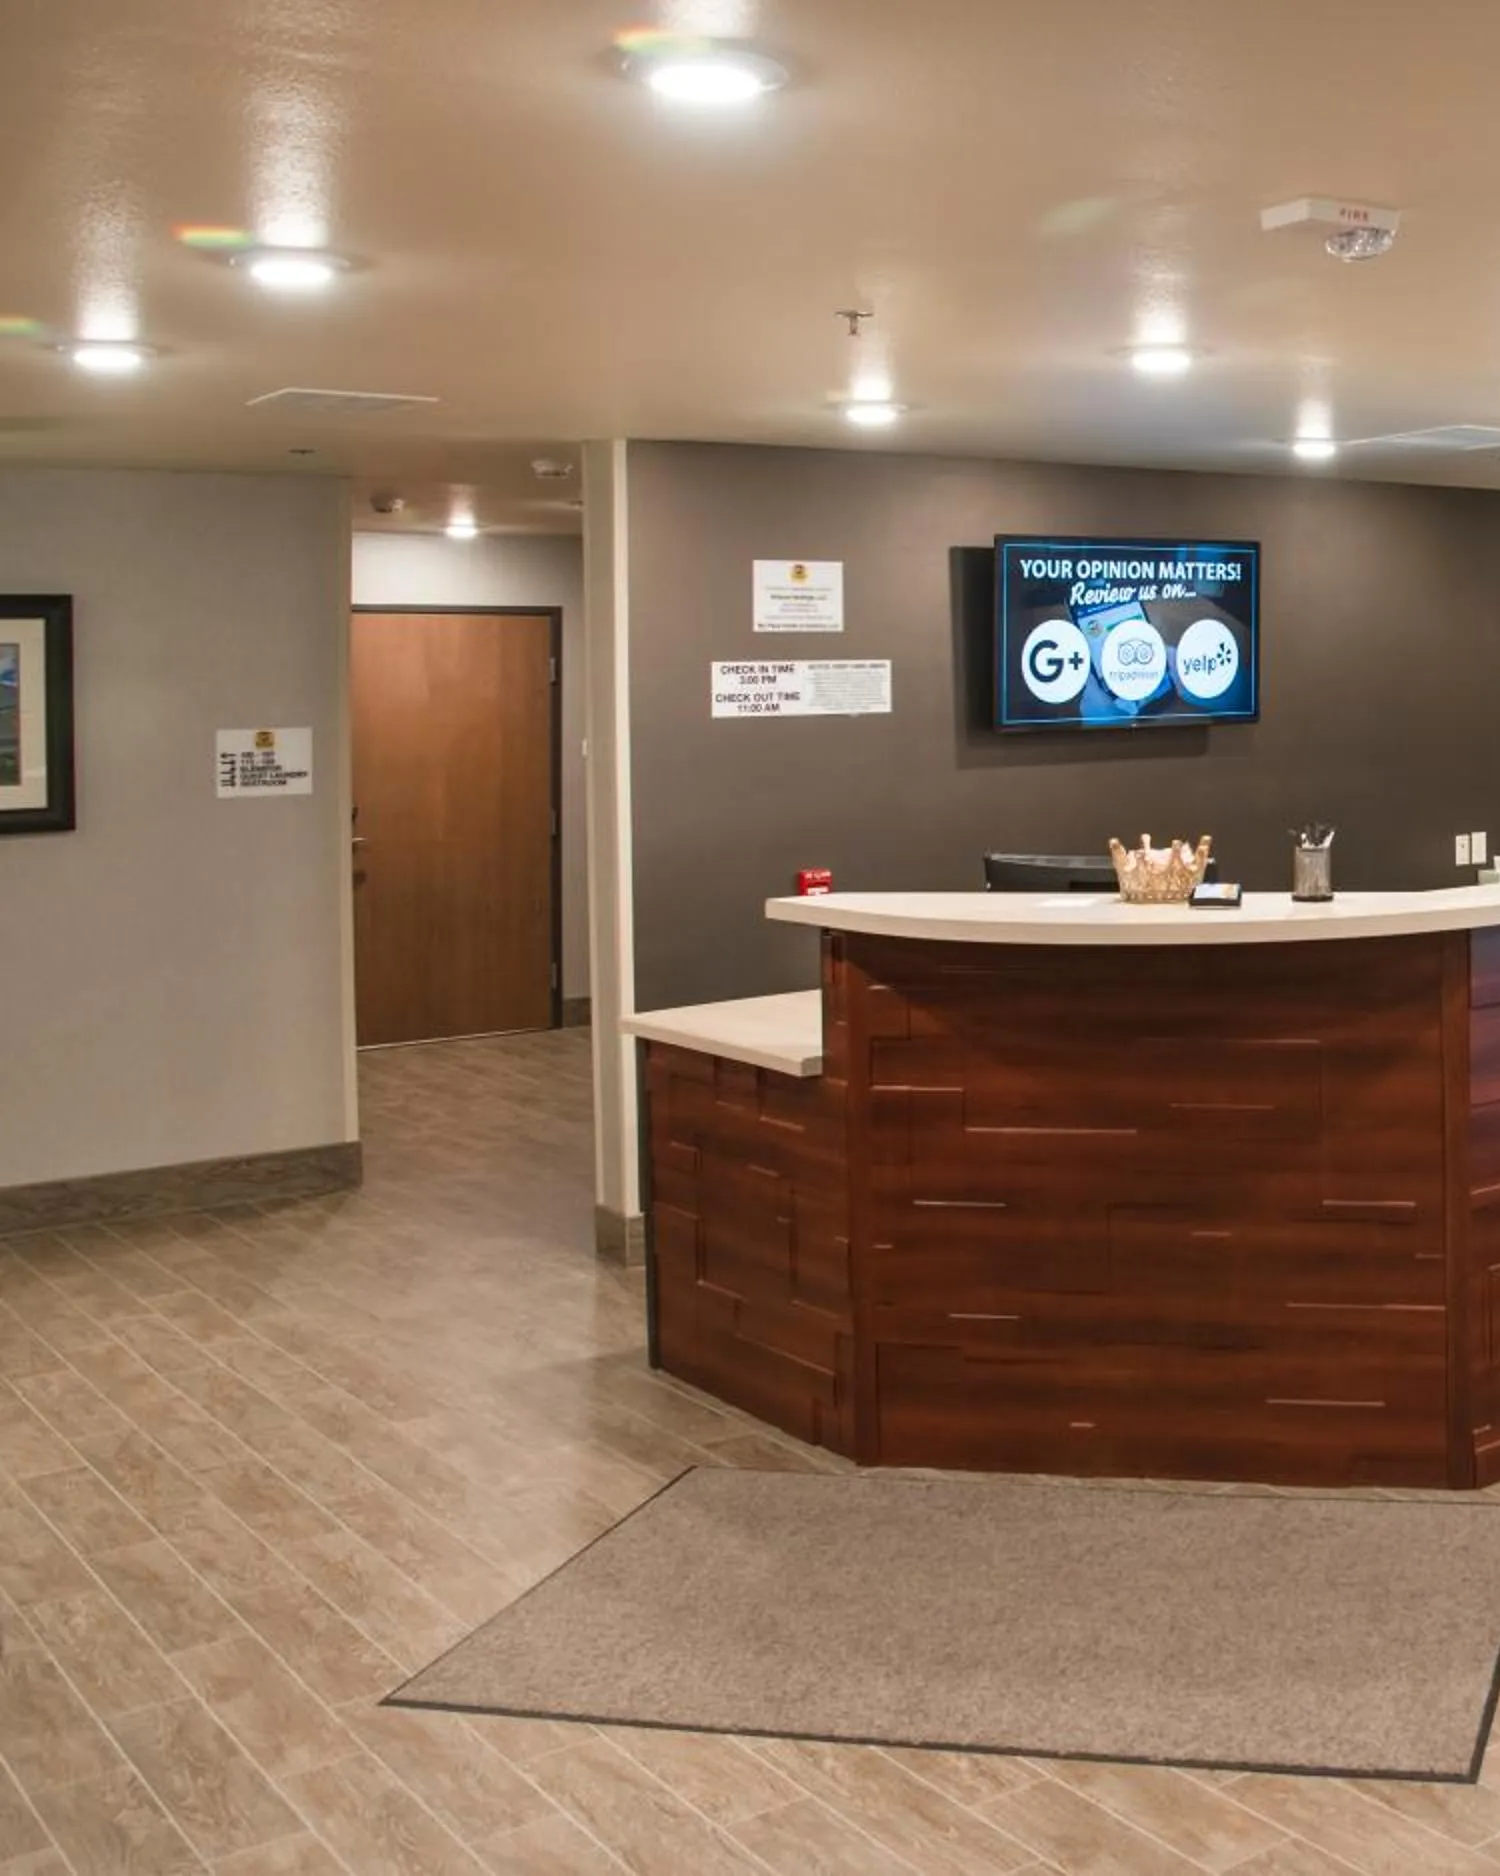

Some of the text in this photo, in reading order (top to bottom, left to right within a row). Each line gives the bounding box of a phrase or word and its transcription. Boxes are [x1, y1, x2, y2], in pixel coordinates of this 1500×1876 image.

[1020, 559, 1241, 581] YOUR OPINION MATTERS!
[1069, 582, 1136, 605] Review
[1139, 585, 1157, 601] us
[720, 664, 796, 675] CHECK IN TIME
[1183, 655, 1217, 676] yelp
[761, 675, 777, 684] PM
[715, 691, 801, 703] CHECK OUT TIME
[764, 703, 780, 712] AM
